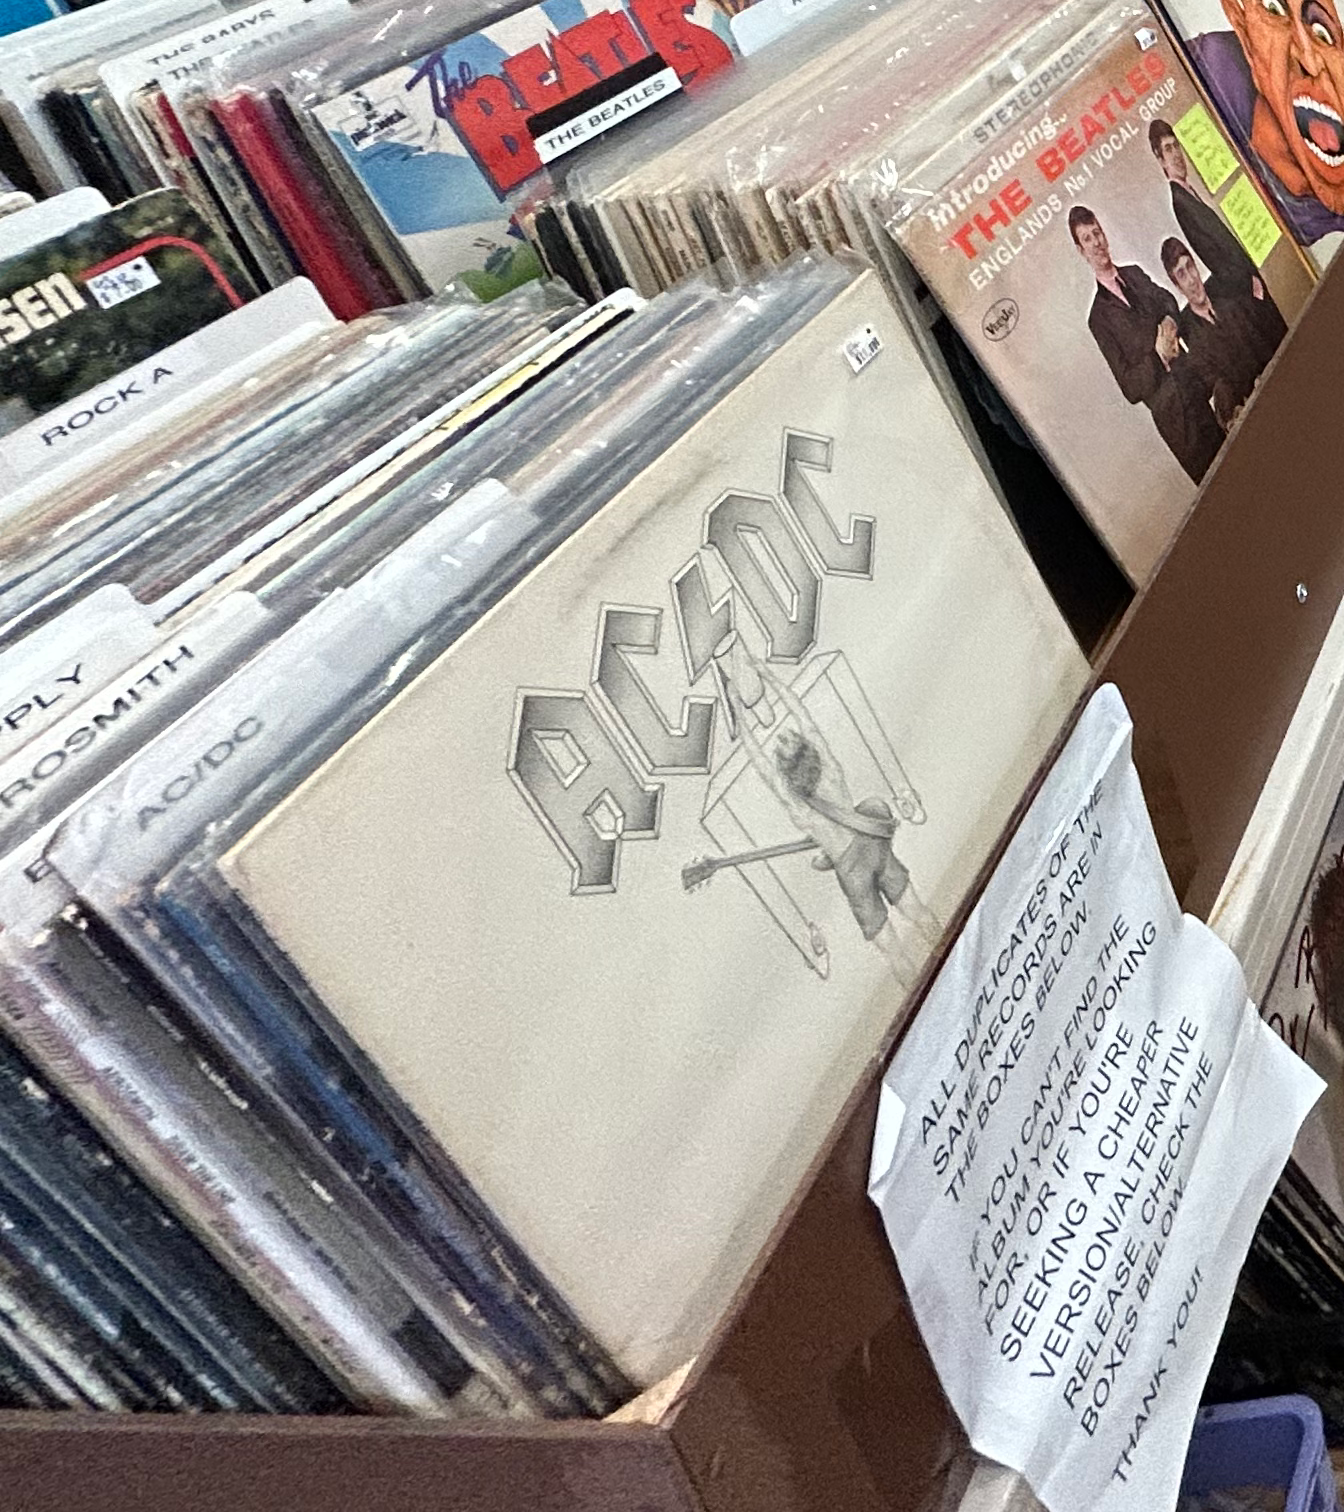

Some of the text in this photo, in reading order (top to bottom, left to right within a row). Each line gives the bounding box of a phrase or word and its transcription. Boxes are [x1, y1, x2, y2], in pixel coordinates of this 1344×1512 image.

[544, 78, 667, 152] THE BEATLES
[950, 178, 1034, 261] THE
[1035, 51, 1167, 185] BEATLES
[968, 193, 1063, 290] ENGLANDS
[1093, 120, 1140, 169] VOCAL
[1138, 76, 1179, 123] GROUP
[41, 365, 175, 447] ROCK A
[136, 715, 264, 832] AC/DC
[920, 778, 1106, 1145] ALL DUPLICATES OF THE
[932, 1066, 982, 1176] SAME
[979, 917, 1060, 1066] RECORDS
[1058, 862, 1093, 919] ARE
[944, 1140, 980, 1204] THE
[979, 1010, 1037, 1140] BOXES
[976, 921, 1158, 1308] ALBUM YOU'RE LOOKING
[982, 1148, 1021, 1227] YOU
[1020, 1055, 1066, 1146] CAN'T
[1064, 973, 1102, 1050] FIND
[1096, 913, 1131, 972] THE
[1026, 1180, 1059, 1238] OR
[1053, 1144, 1075, 1181] IF
[1068, 1020, 1136, 1138] YOU'RE
[1140, 1119, 1190, 1226] CHECK
[1183, 1051, 1215, 1115] THE
[1000, 1019, 1165, 1363] SEEKING A CHEAPER
[1029, 1014, 1201, 1381] VERSION/ALTERNATIVE
[1078, 1304, 1140, 1438] BOXES
[1111, 1266, 1205, 1485] THANK YOU!
